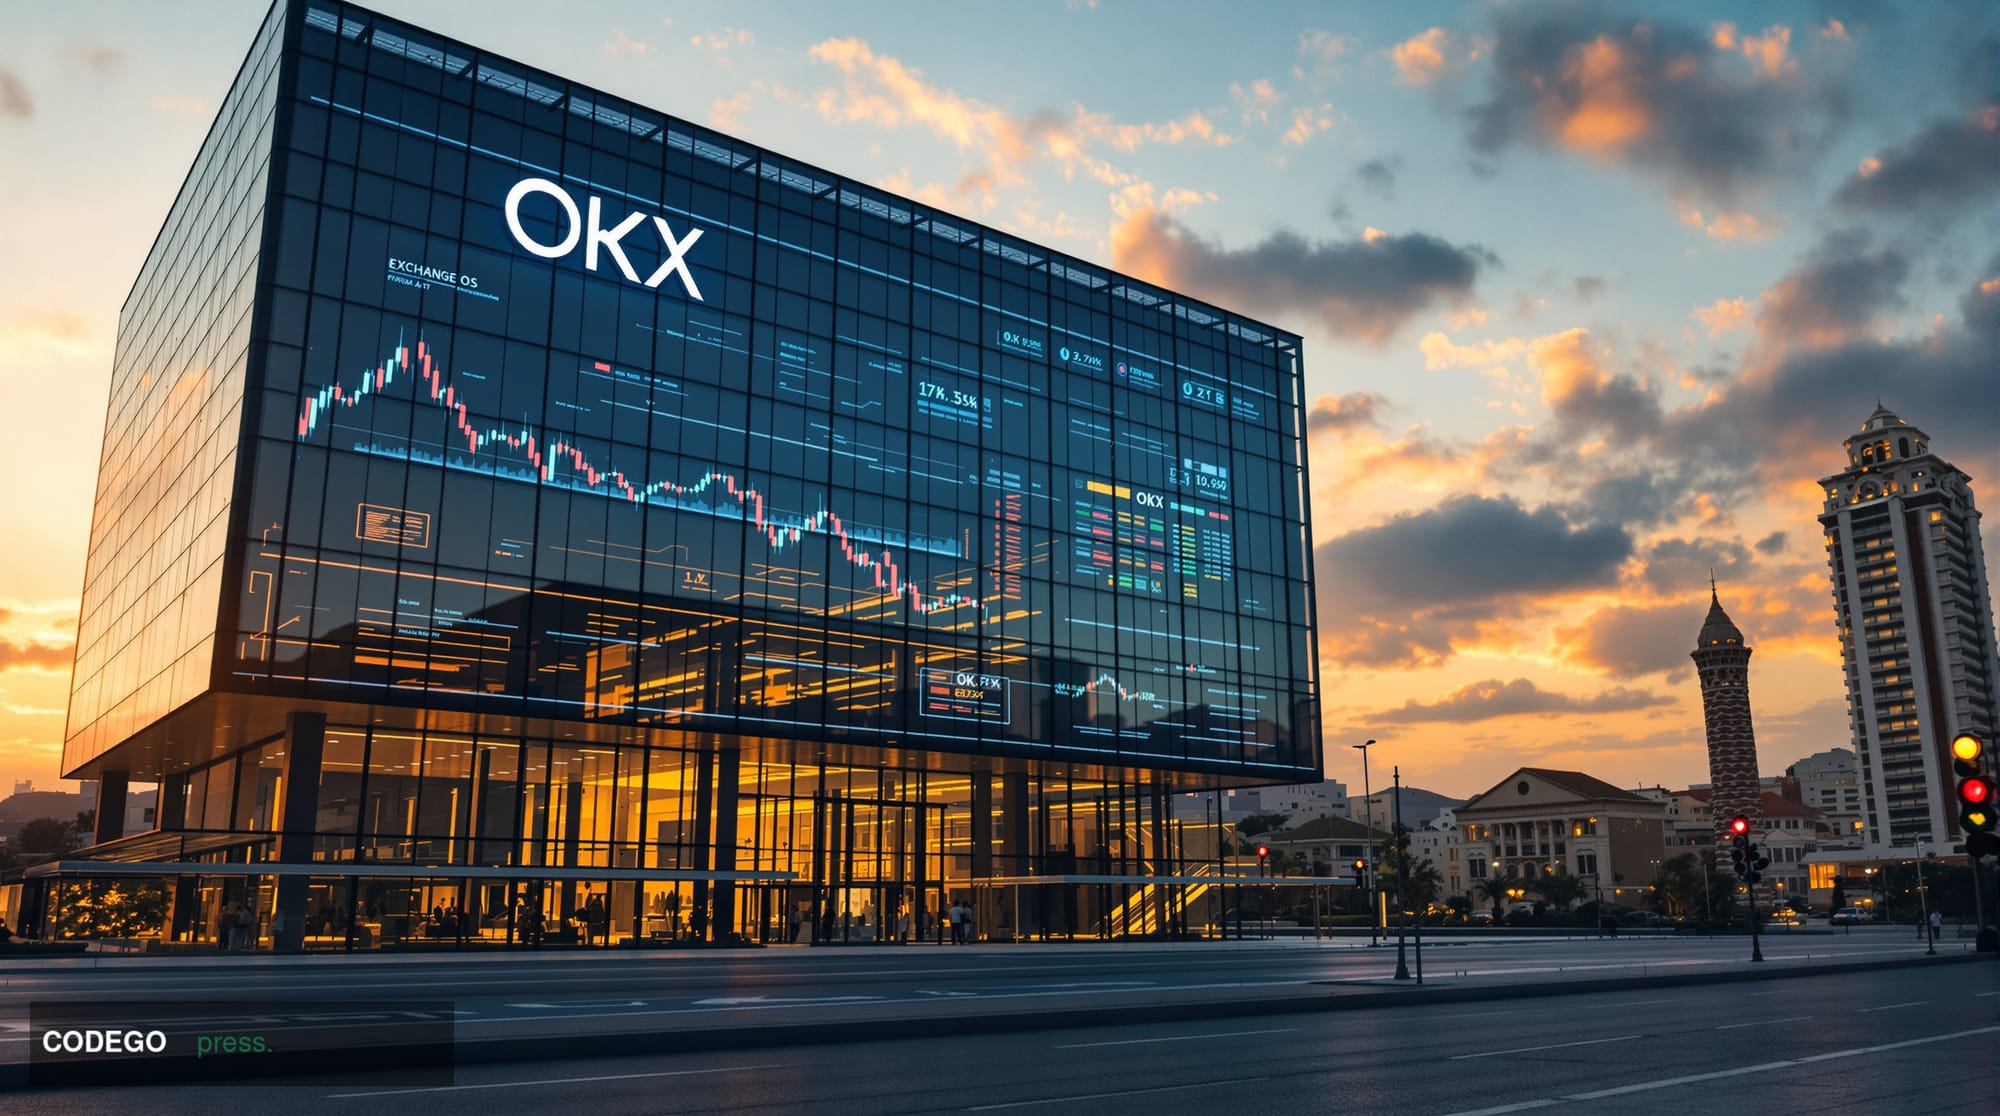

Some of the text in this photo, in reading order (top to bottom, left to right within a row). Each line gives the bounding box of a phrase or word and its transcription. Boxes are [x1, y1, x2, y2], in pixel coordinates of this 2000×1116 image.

[505, 178, 704, 301] OKX
[388, 257, 457, 284] EXCHANGE
[460, 275, 479, 289] OS
[1136, 491, 1165, 510] OKX
